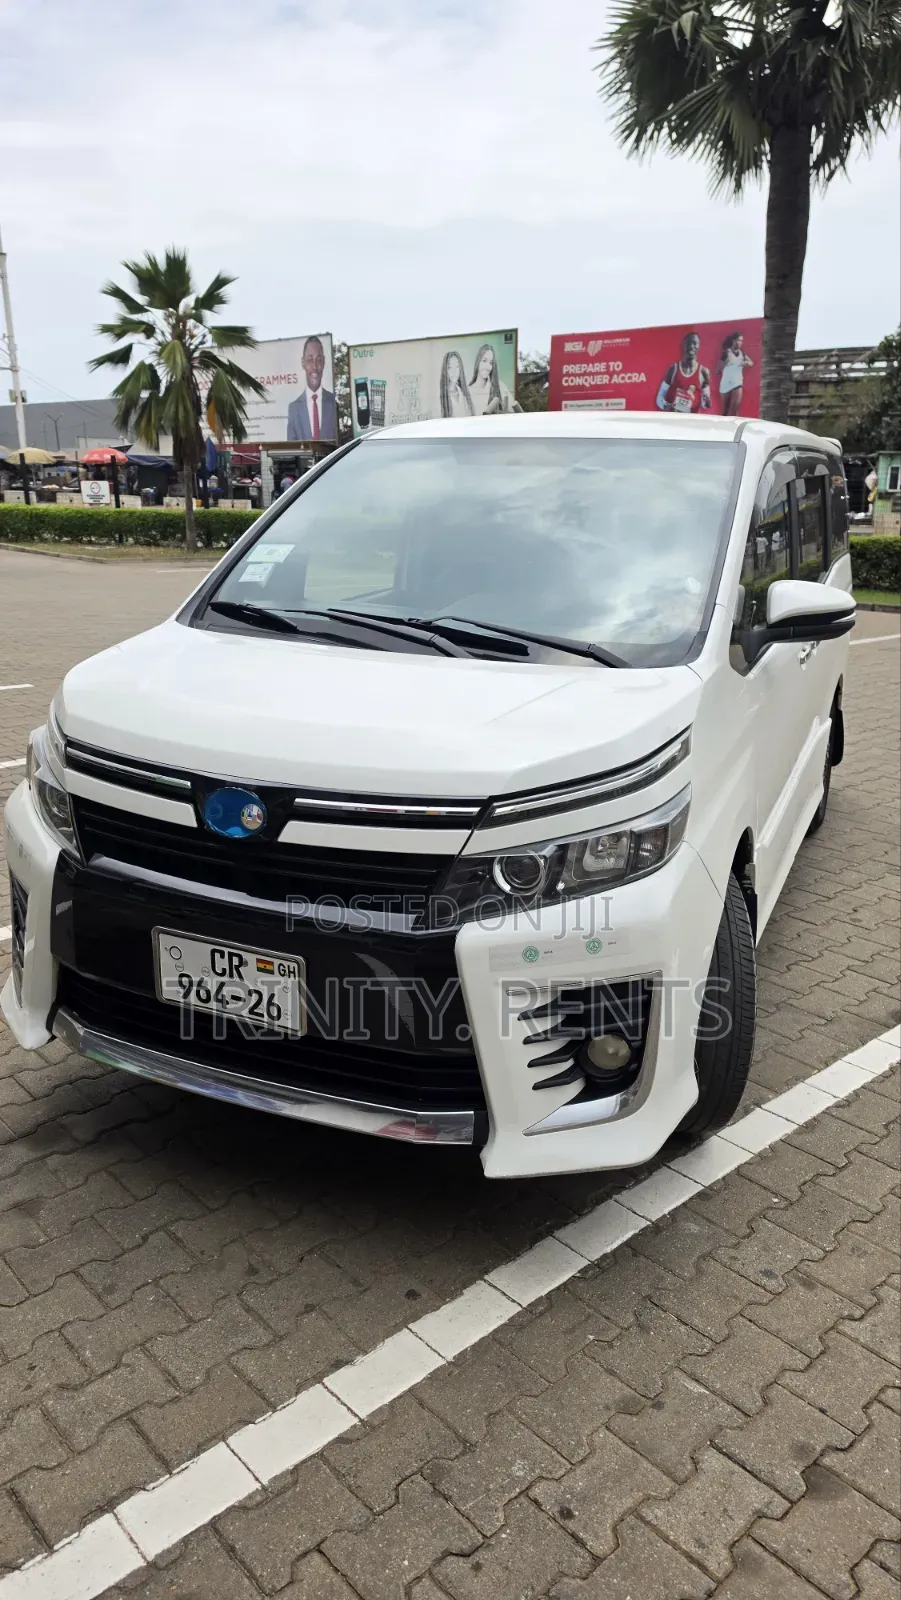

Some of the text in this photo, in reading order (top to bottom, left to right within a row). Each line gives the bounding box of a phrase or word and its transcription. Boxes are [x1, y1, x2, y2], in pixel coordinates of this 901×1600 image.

[562, 361, 623, 375] PREPARE TO
[254, 373, 299, 387] GRAMMES
[562, 372, 647, 387] CONQUER ACCRA
[210, 948, 245, 982] CR
[277, 962, 297, 980] GH
[177, 972, 282, 1022] 964-26
